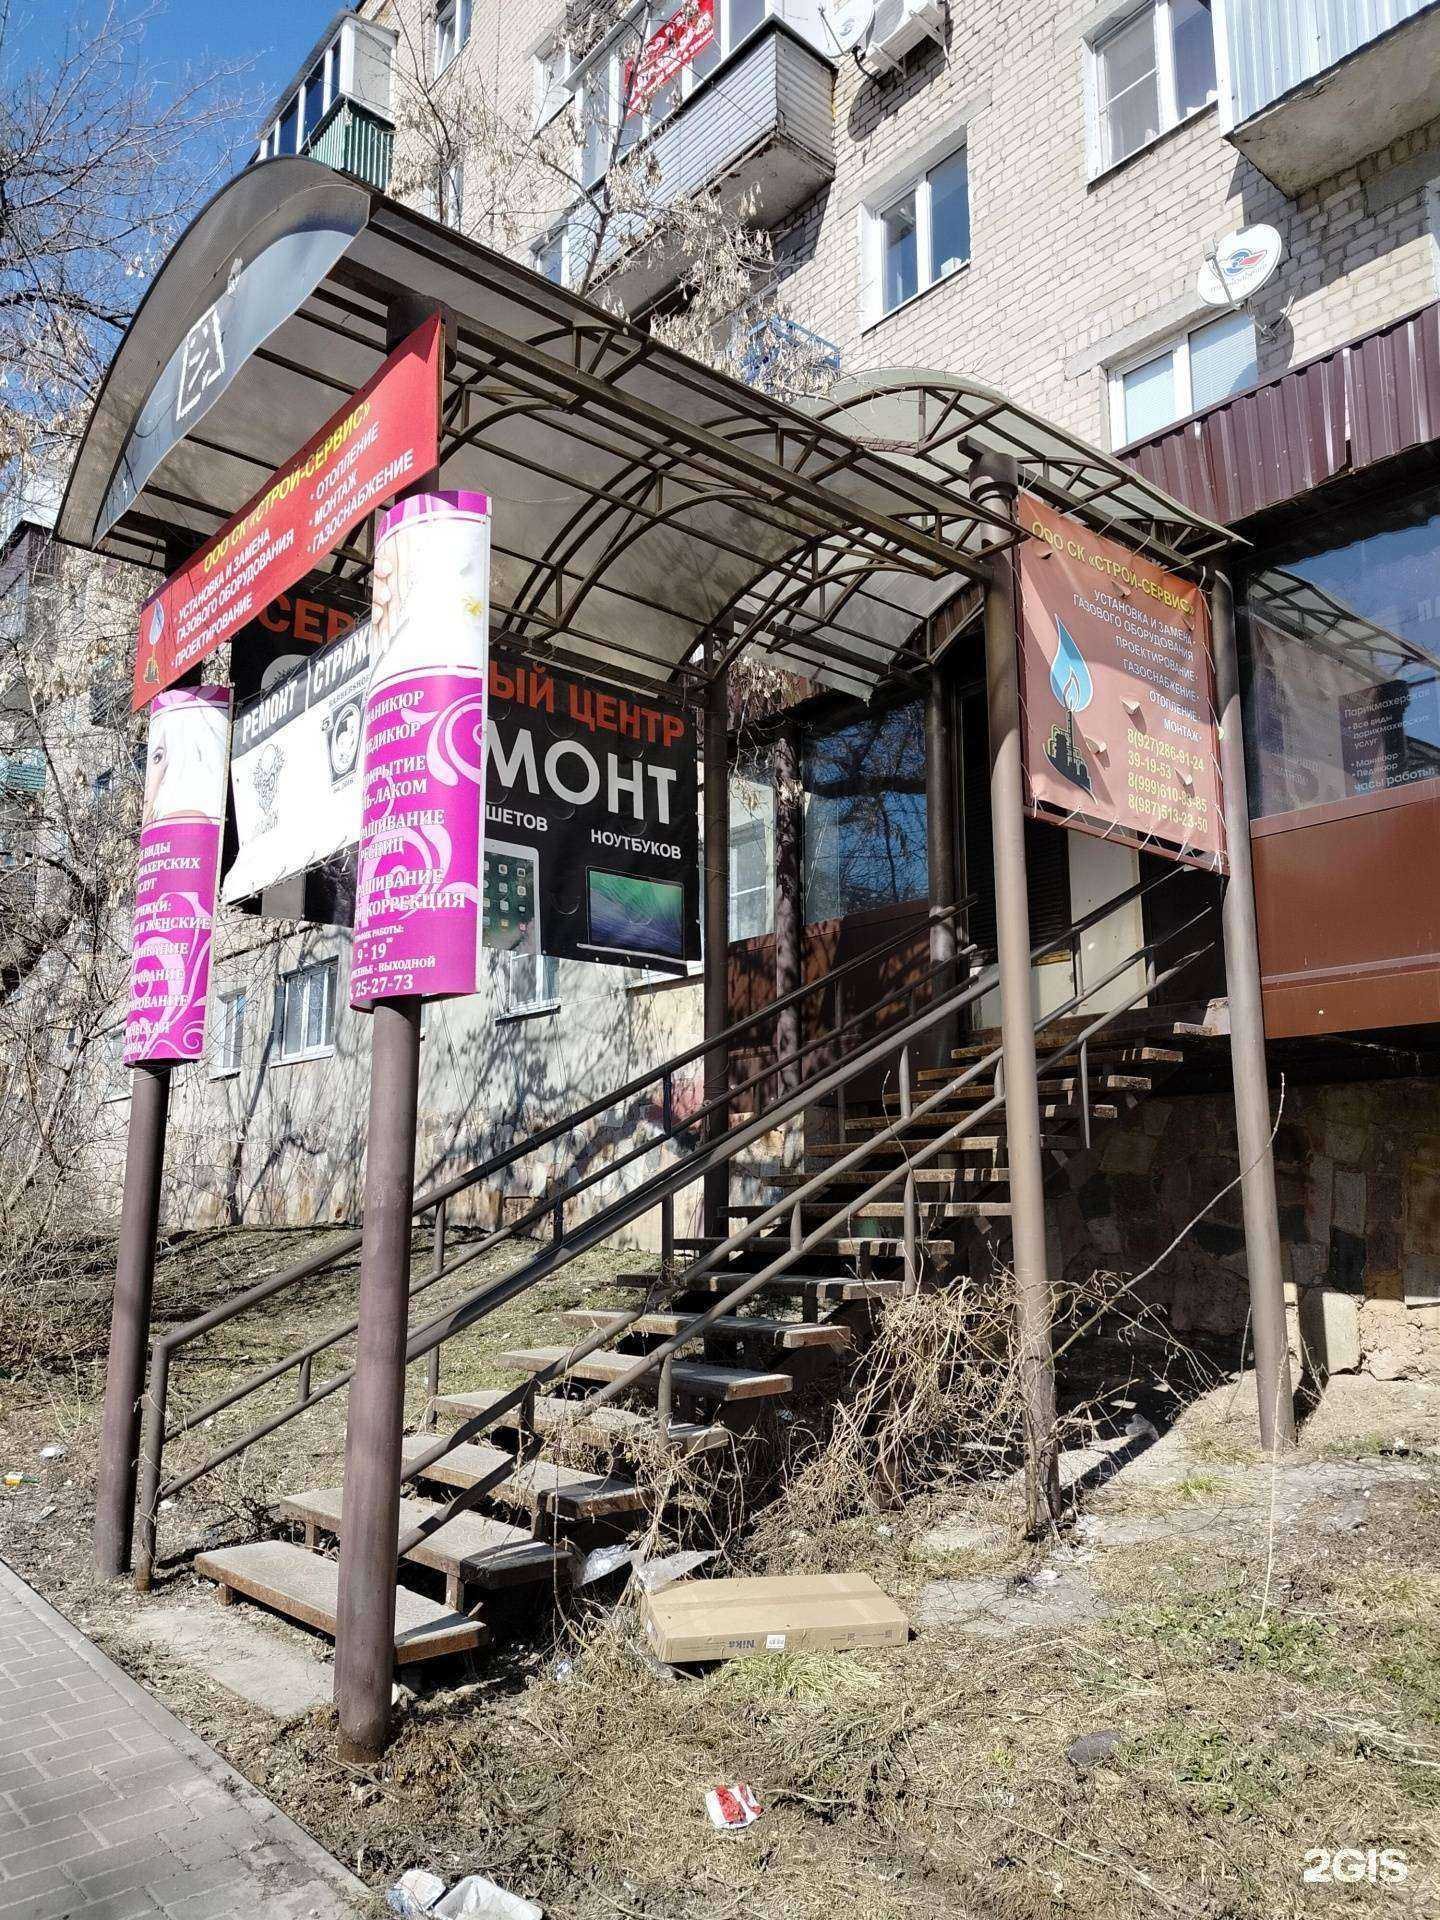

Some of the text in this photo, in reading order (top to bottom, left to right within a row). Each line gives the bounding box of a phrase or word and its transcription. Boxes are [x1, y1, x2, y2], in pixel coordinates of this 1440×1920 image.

[316, 421, 379, 500] ОТОПЛЕНИЕ
[312, 448, 414, 554] ГАЗОСНАБЖЕНИЕ
[314, 468, 357, 527] МОНТАЖ
[204, 541, 229, 572] ООО
[231, 517, 247, 545] СК
[1032, 521, 1064, 551] ООО
[1067, 541, 1085, 562] СК
[176, 528, 295, 644] ГАЗОВОГО ОБОРУДОВАНИЯ
[178, 528, 271, 623] УСТАНОВКА И ЗАМЕНА
[175, 592, 253, 668] ПРОЕКТИРОВАНИЕ
[1073, 593, 1194, 662] ГАЗОВОГО ОБОРУДОВАНИЯ
[1094, 589, 1192, 646] УСТАНОВКА И ЗАМЕНА
[242, 626, 371, 744] РЕМОНТ СТРИЖ
[1115, 635, 1196, 682] ПРОЕКТИРОВАНИЕ
[1122, 658, 1197, 702] ГАЗОСНАБЖЕНИЕ
[569, 684, 685, 747] ЦЕНТР
[1149, 690, 1198, 722] ОТОПЛЕНИЕ
[1163, 718, 1200, 743] МОНТАЖ
[366, 721, 421, 755] ЕДИКЮР
[486, 719, 677, 825] МОНТ
[486, 804, 548, 832] ШЕТОВ
[590, 829, 682, 860] НОУТБУКОВ
[379, 955, 436, 973] ВЫХОДНОЙ
